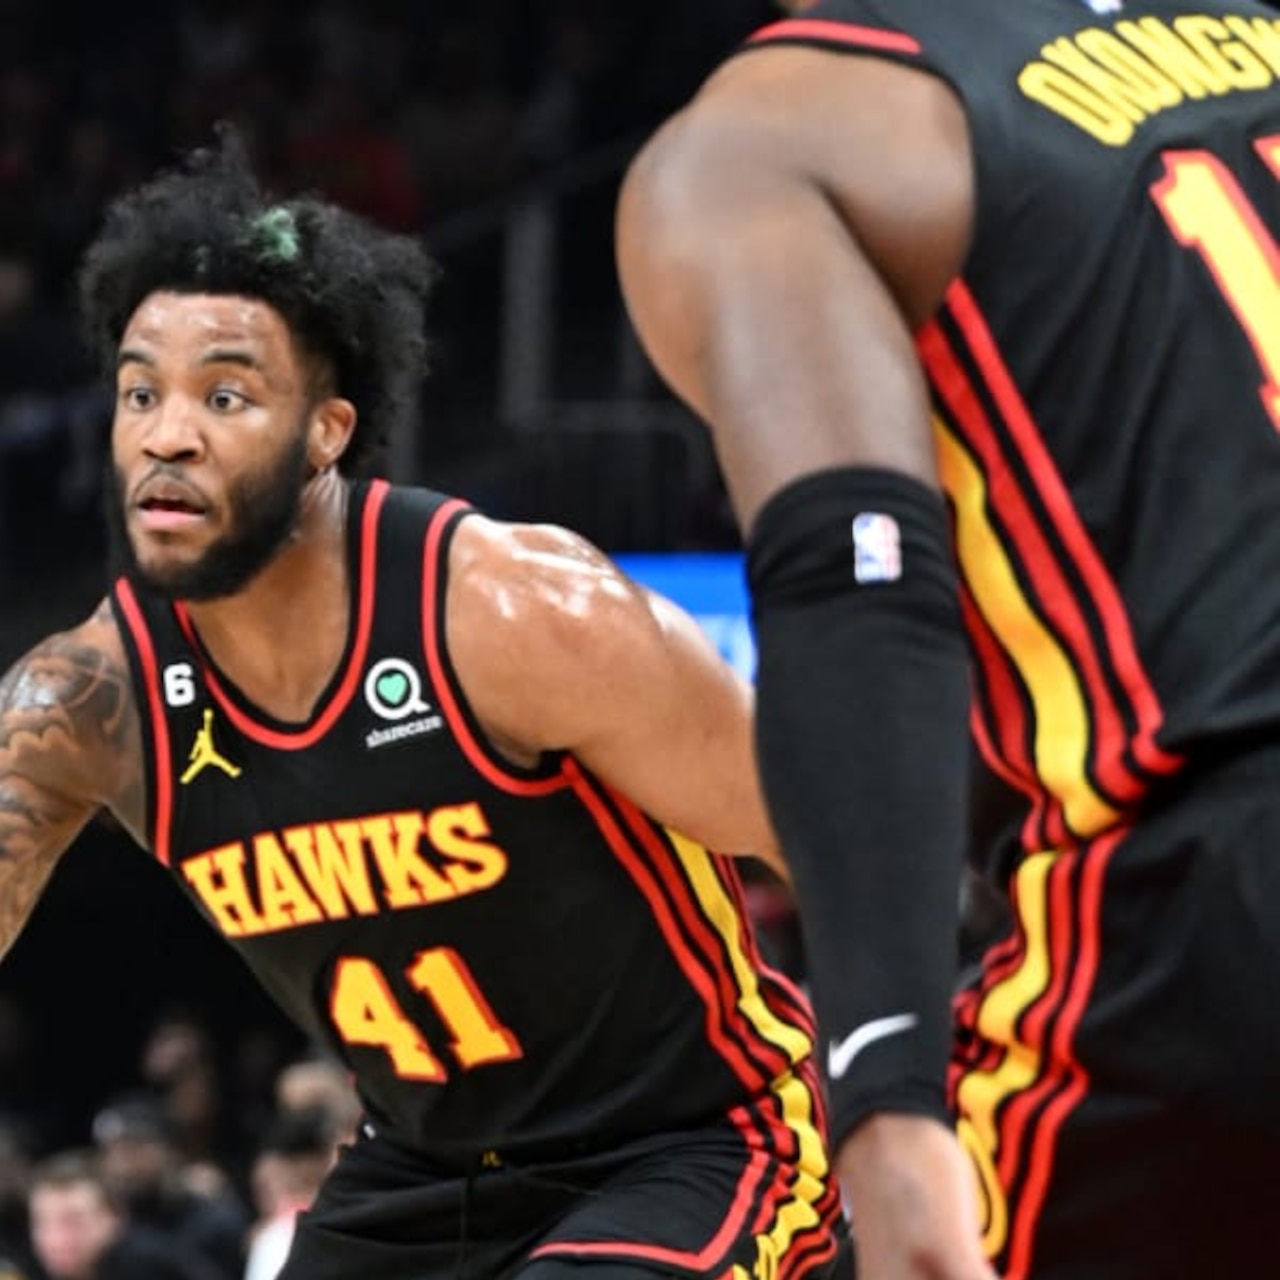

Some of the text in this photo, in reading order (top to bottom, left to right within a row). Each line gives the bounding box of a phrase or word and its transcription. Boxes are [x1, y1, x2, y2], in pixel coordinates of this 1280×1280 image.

[1149, 133, 1280, 437] 1
[162, 663, 195, 706] 6
[181, 801, 508, 938] HAWKS
[330, 945, 524, 1083] 41
